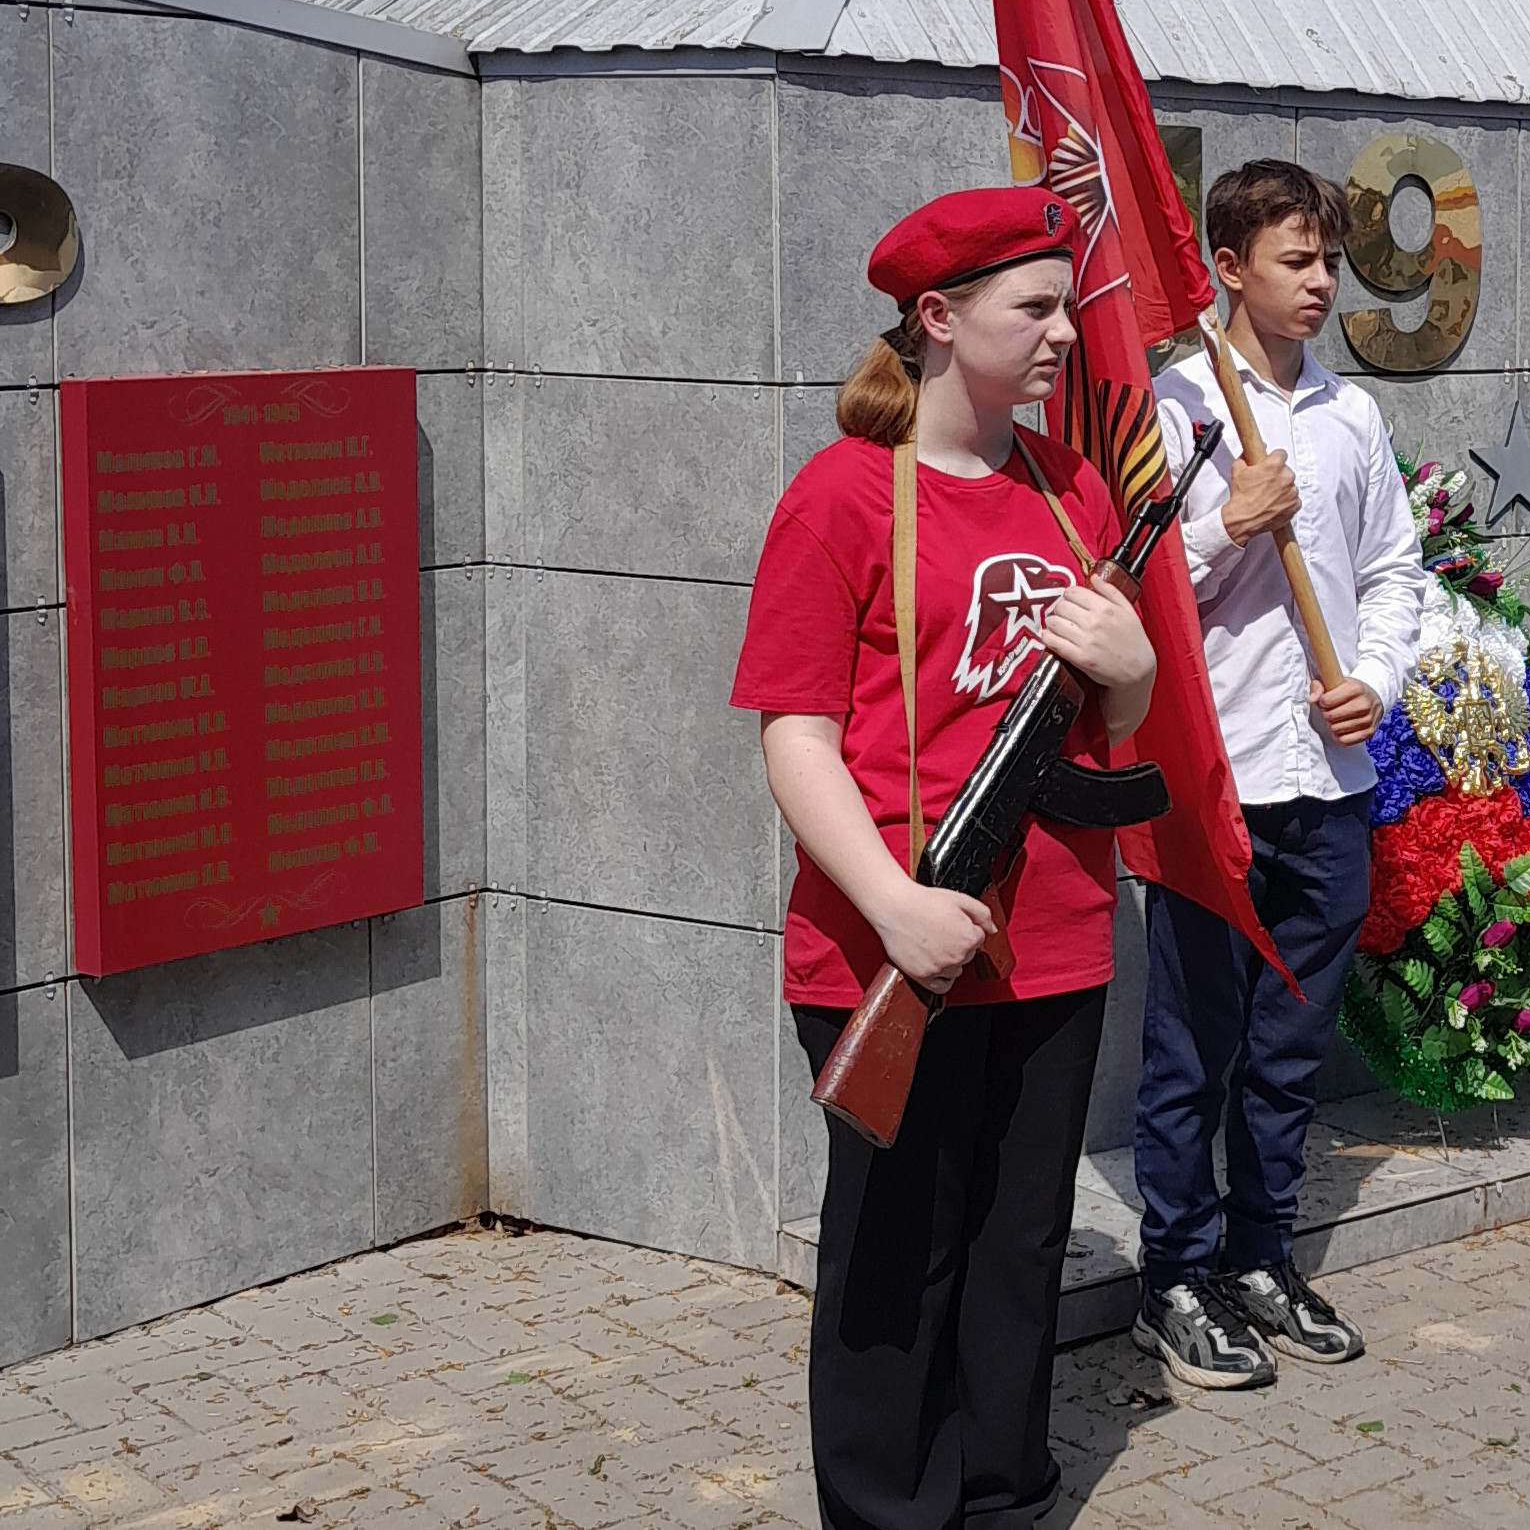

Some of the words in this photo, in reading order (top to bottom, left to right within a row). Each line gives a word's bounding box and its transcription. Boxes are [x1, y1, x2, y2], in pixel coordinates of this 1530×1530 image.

[260, 440, 341, 461] Матюшин
[104, 717, 193, 747] Матюшин
[105, 755, 193, 787] Матюшин
[106, 793, 194, 826] Матюшин
[107, 830, 195, 865] Матюшин
[108, 868, 196, 904] Матюшин
